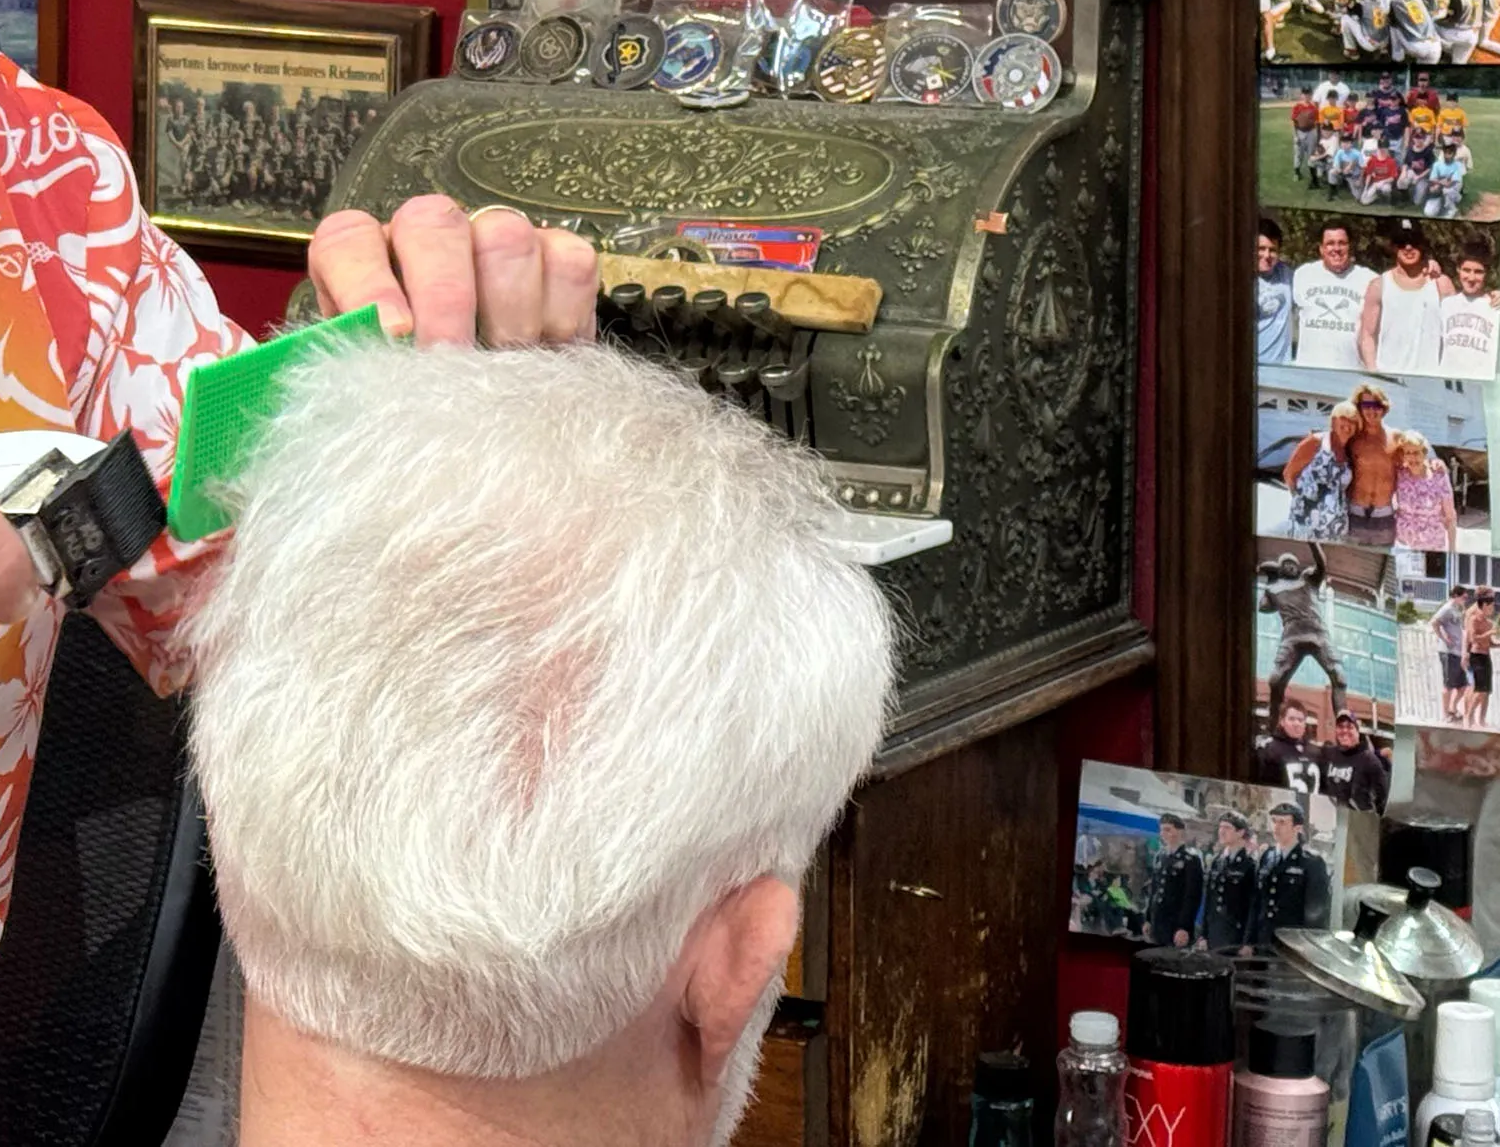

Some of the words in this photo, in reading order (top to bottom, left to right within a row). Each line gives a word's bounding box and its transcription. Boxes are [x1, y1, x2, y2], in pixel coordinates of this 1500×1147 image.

[207, 57, 251, 73] lacrosse
[253, 61, 280, 76] team
[282, 61, 326, 79] features
[329, 64, 386, 83] Richmond
[1305, 319, 1357, 333] LACROSSE
